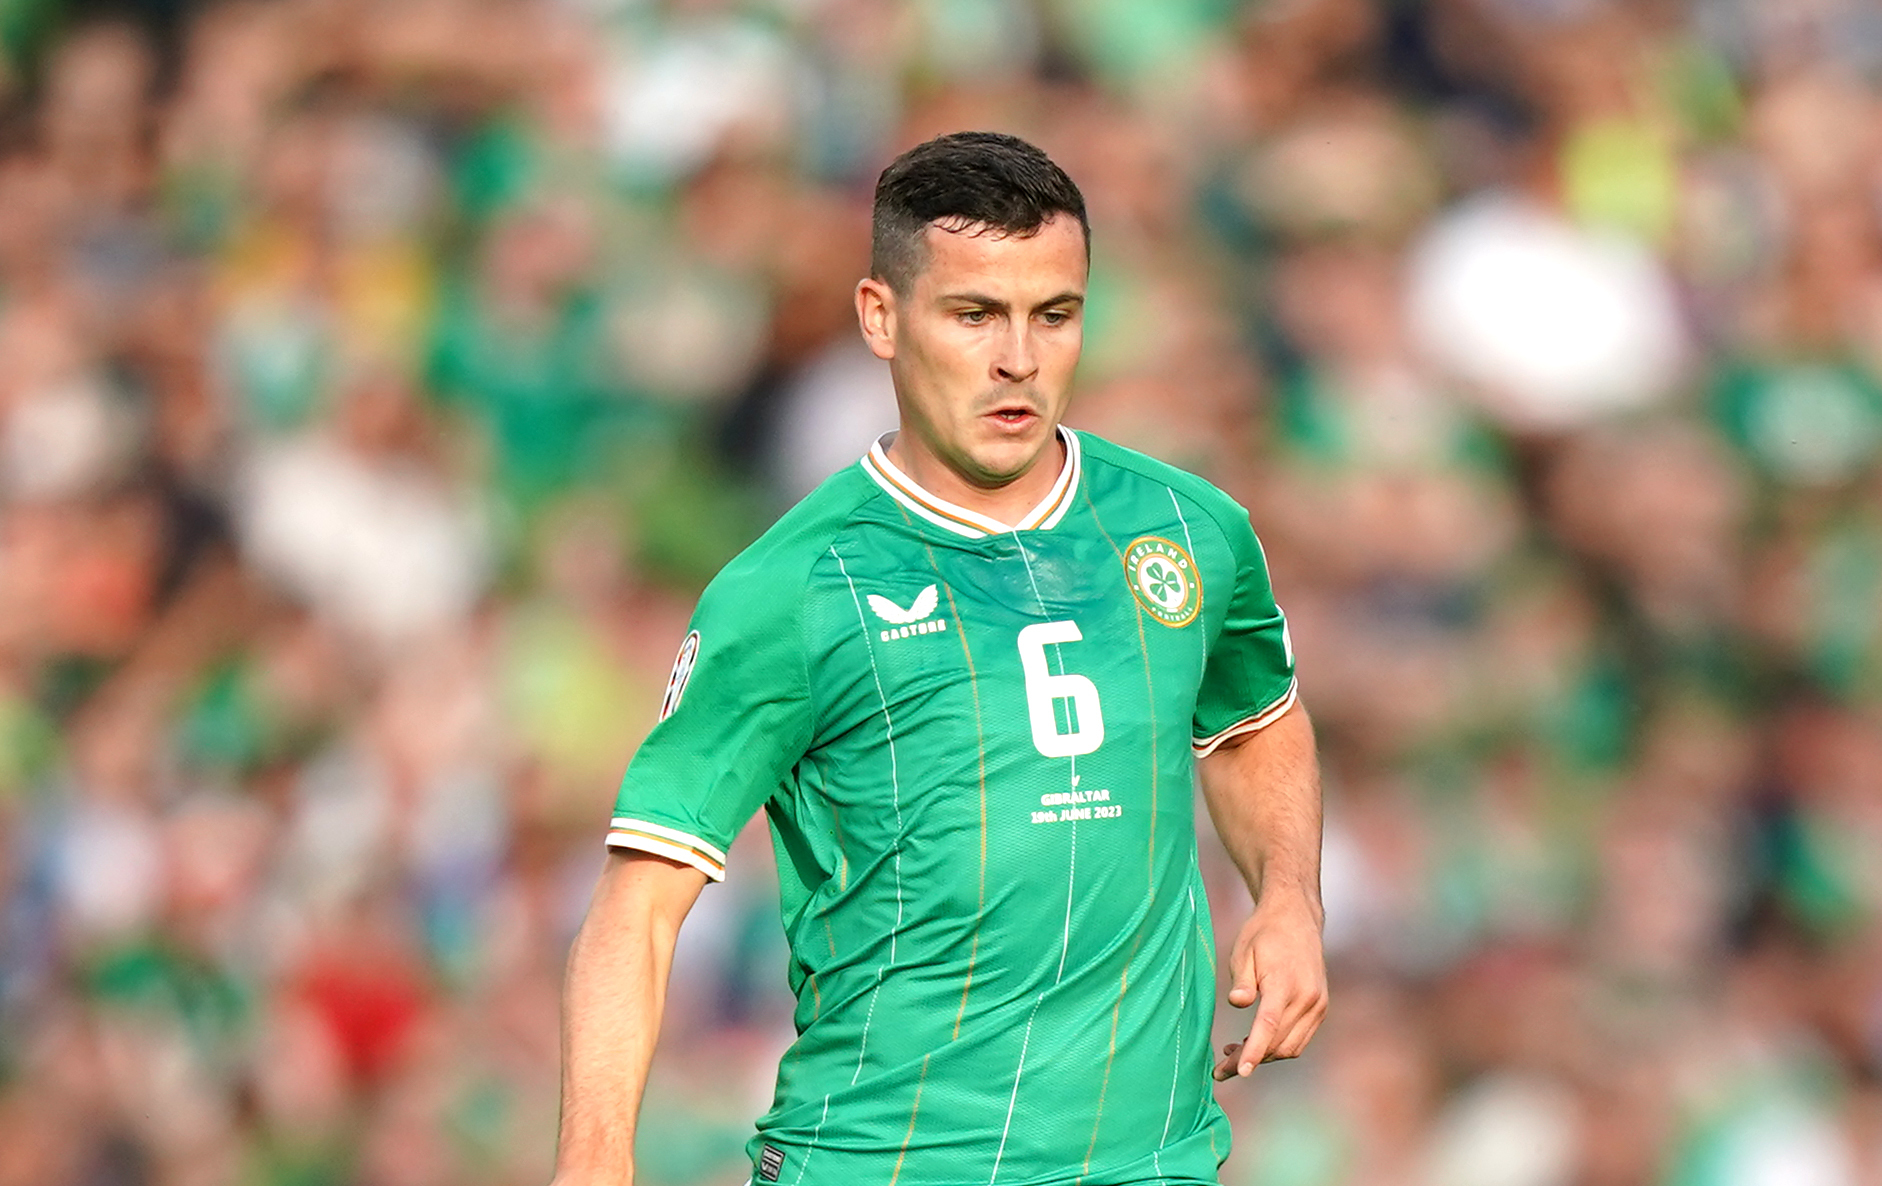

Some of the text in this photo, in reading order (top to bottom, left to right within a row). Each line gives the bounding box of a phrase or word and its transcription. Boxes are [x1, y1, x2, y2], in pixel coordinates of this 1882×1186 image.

[1128, 543, 1188, 569] IRELAND
[1017, 619, 1105, 758] 6
[1041, 789, 1110, 806] GIBRALTAR
[1030, 804, 1122, 824] 19th JUNE 2023
